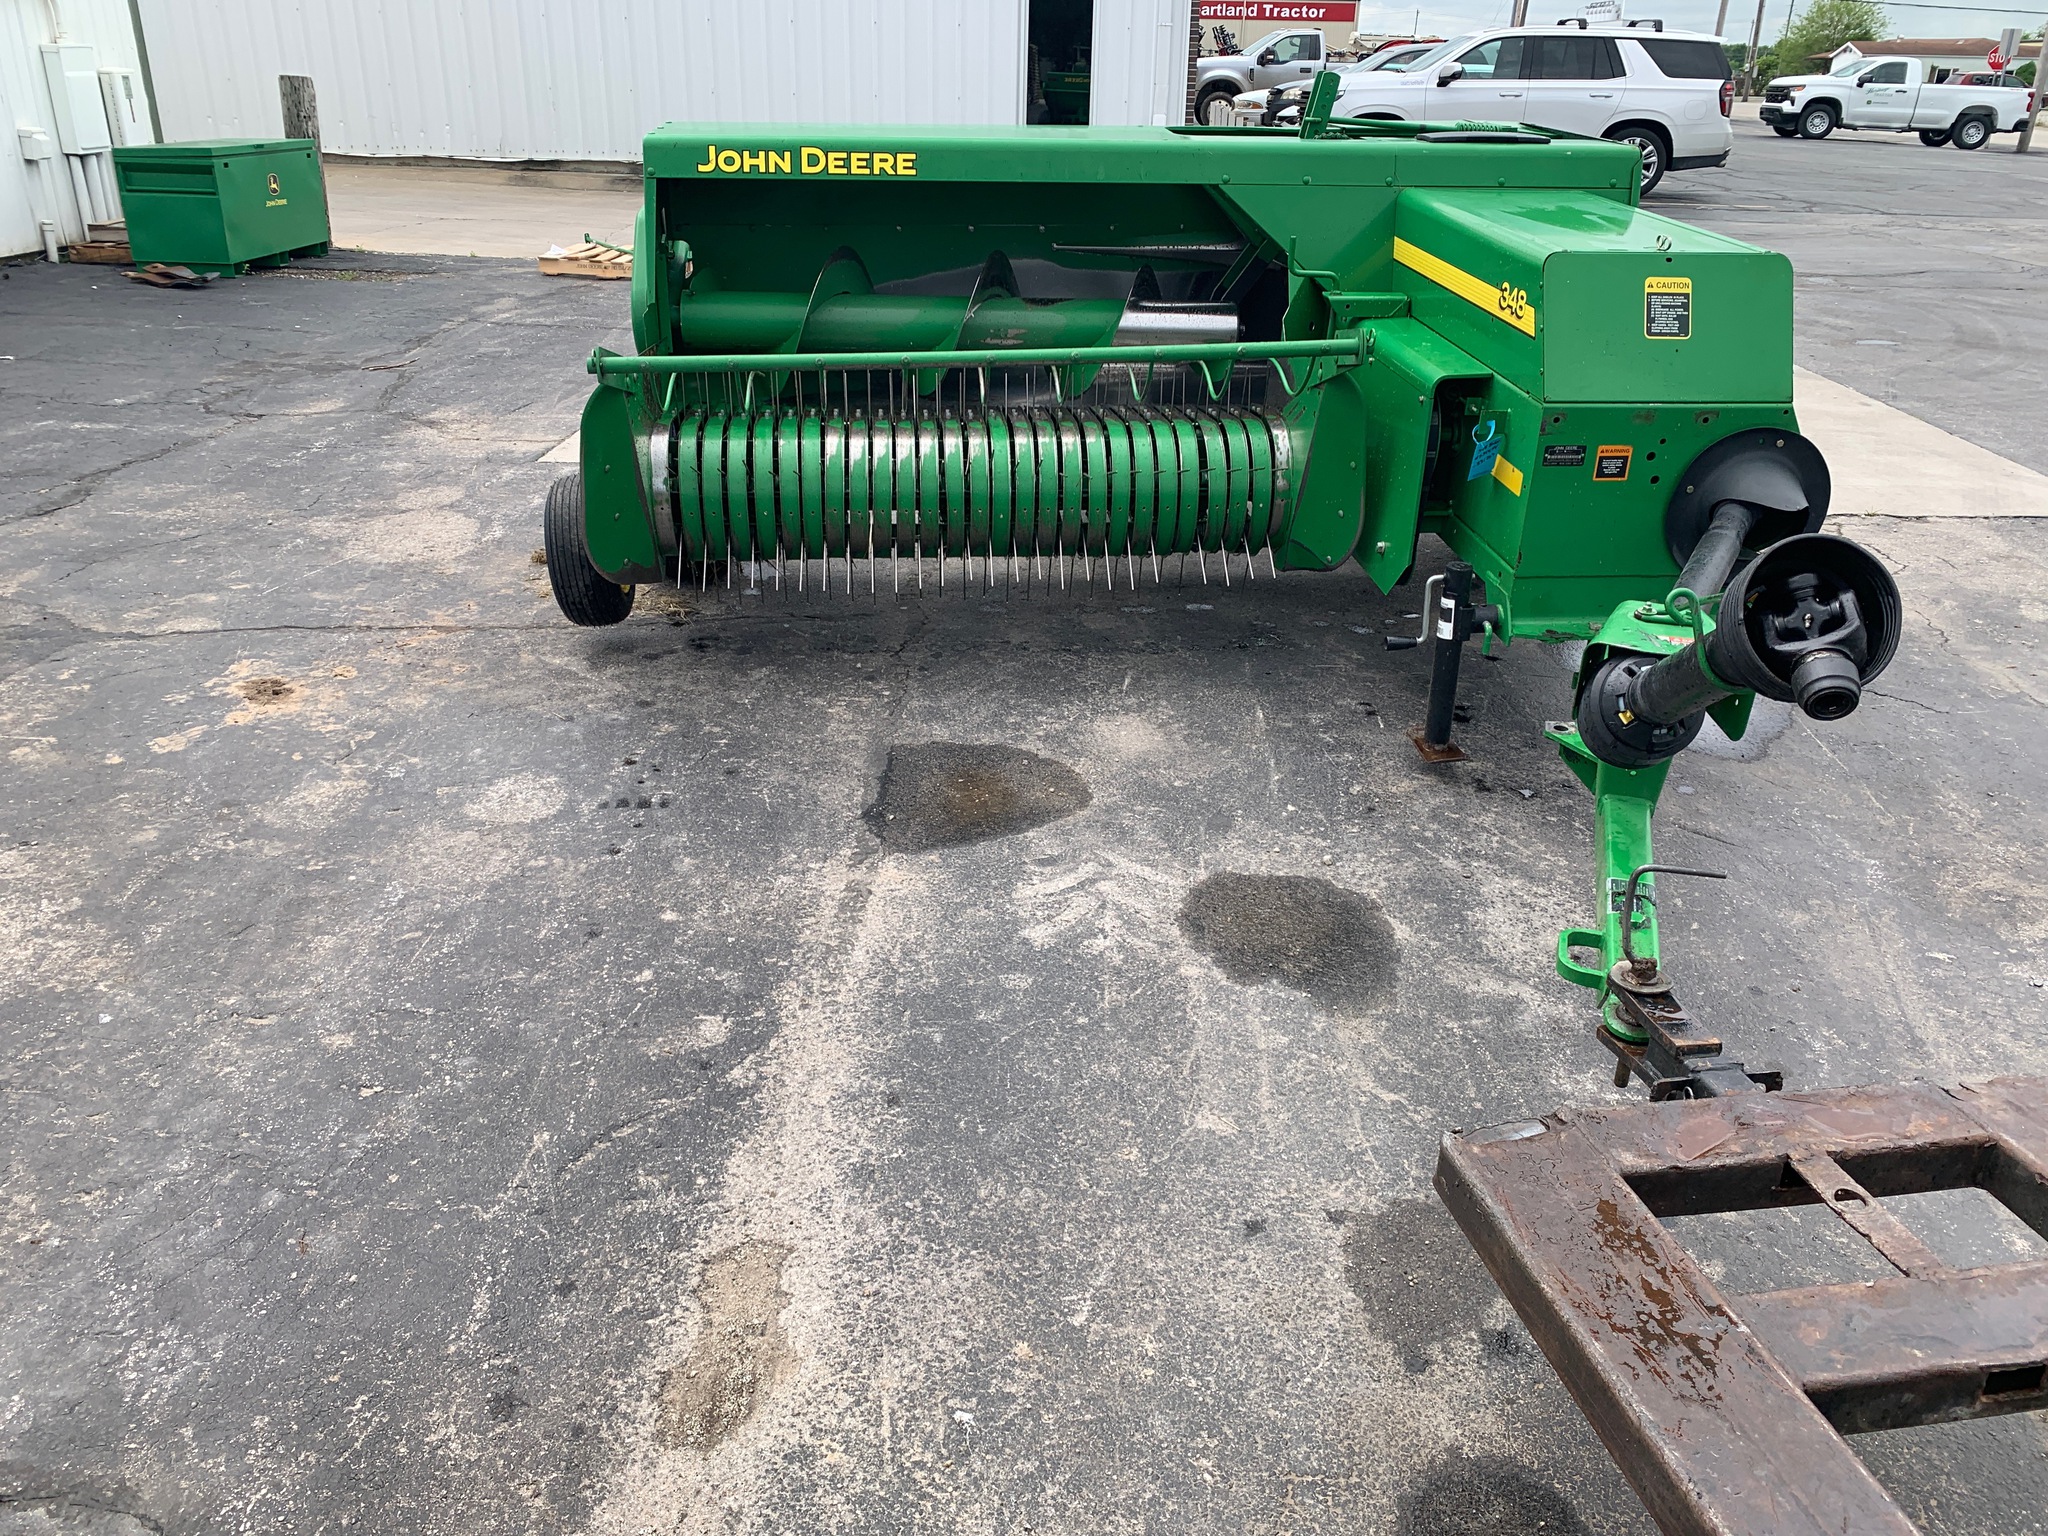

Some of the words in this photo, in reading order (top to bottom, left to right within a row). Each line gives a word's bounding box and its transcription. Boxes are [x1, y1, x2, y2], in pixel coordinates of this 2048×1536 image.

[1199, 4, 1257, 16] artland
[1263, 4, 1326, 18] Tractor
[1989, 53, 2005, 63] STO
[697, 144, 792, 173] JOHN
[800, 146, 917, 175] DEERE
[1656, 281, 1690, 289] CAUTION
[1499, 281, 1527, 320] 348
